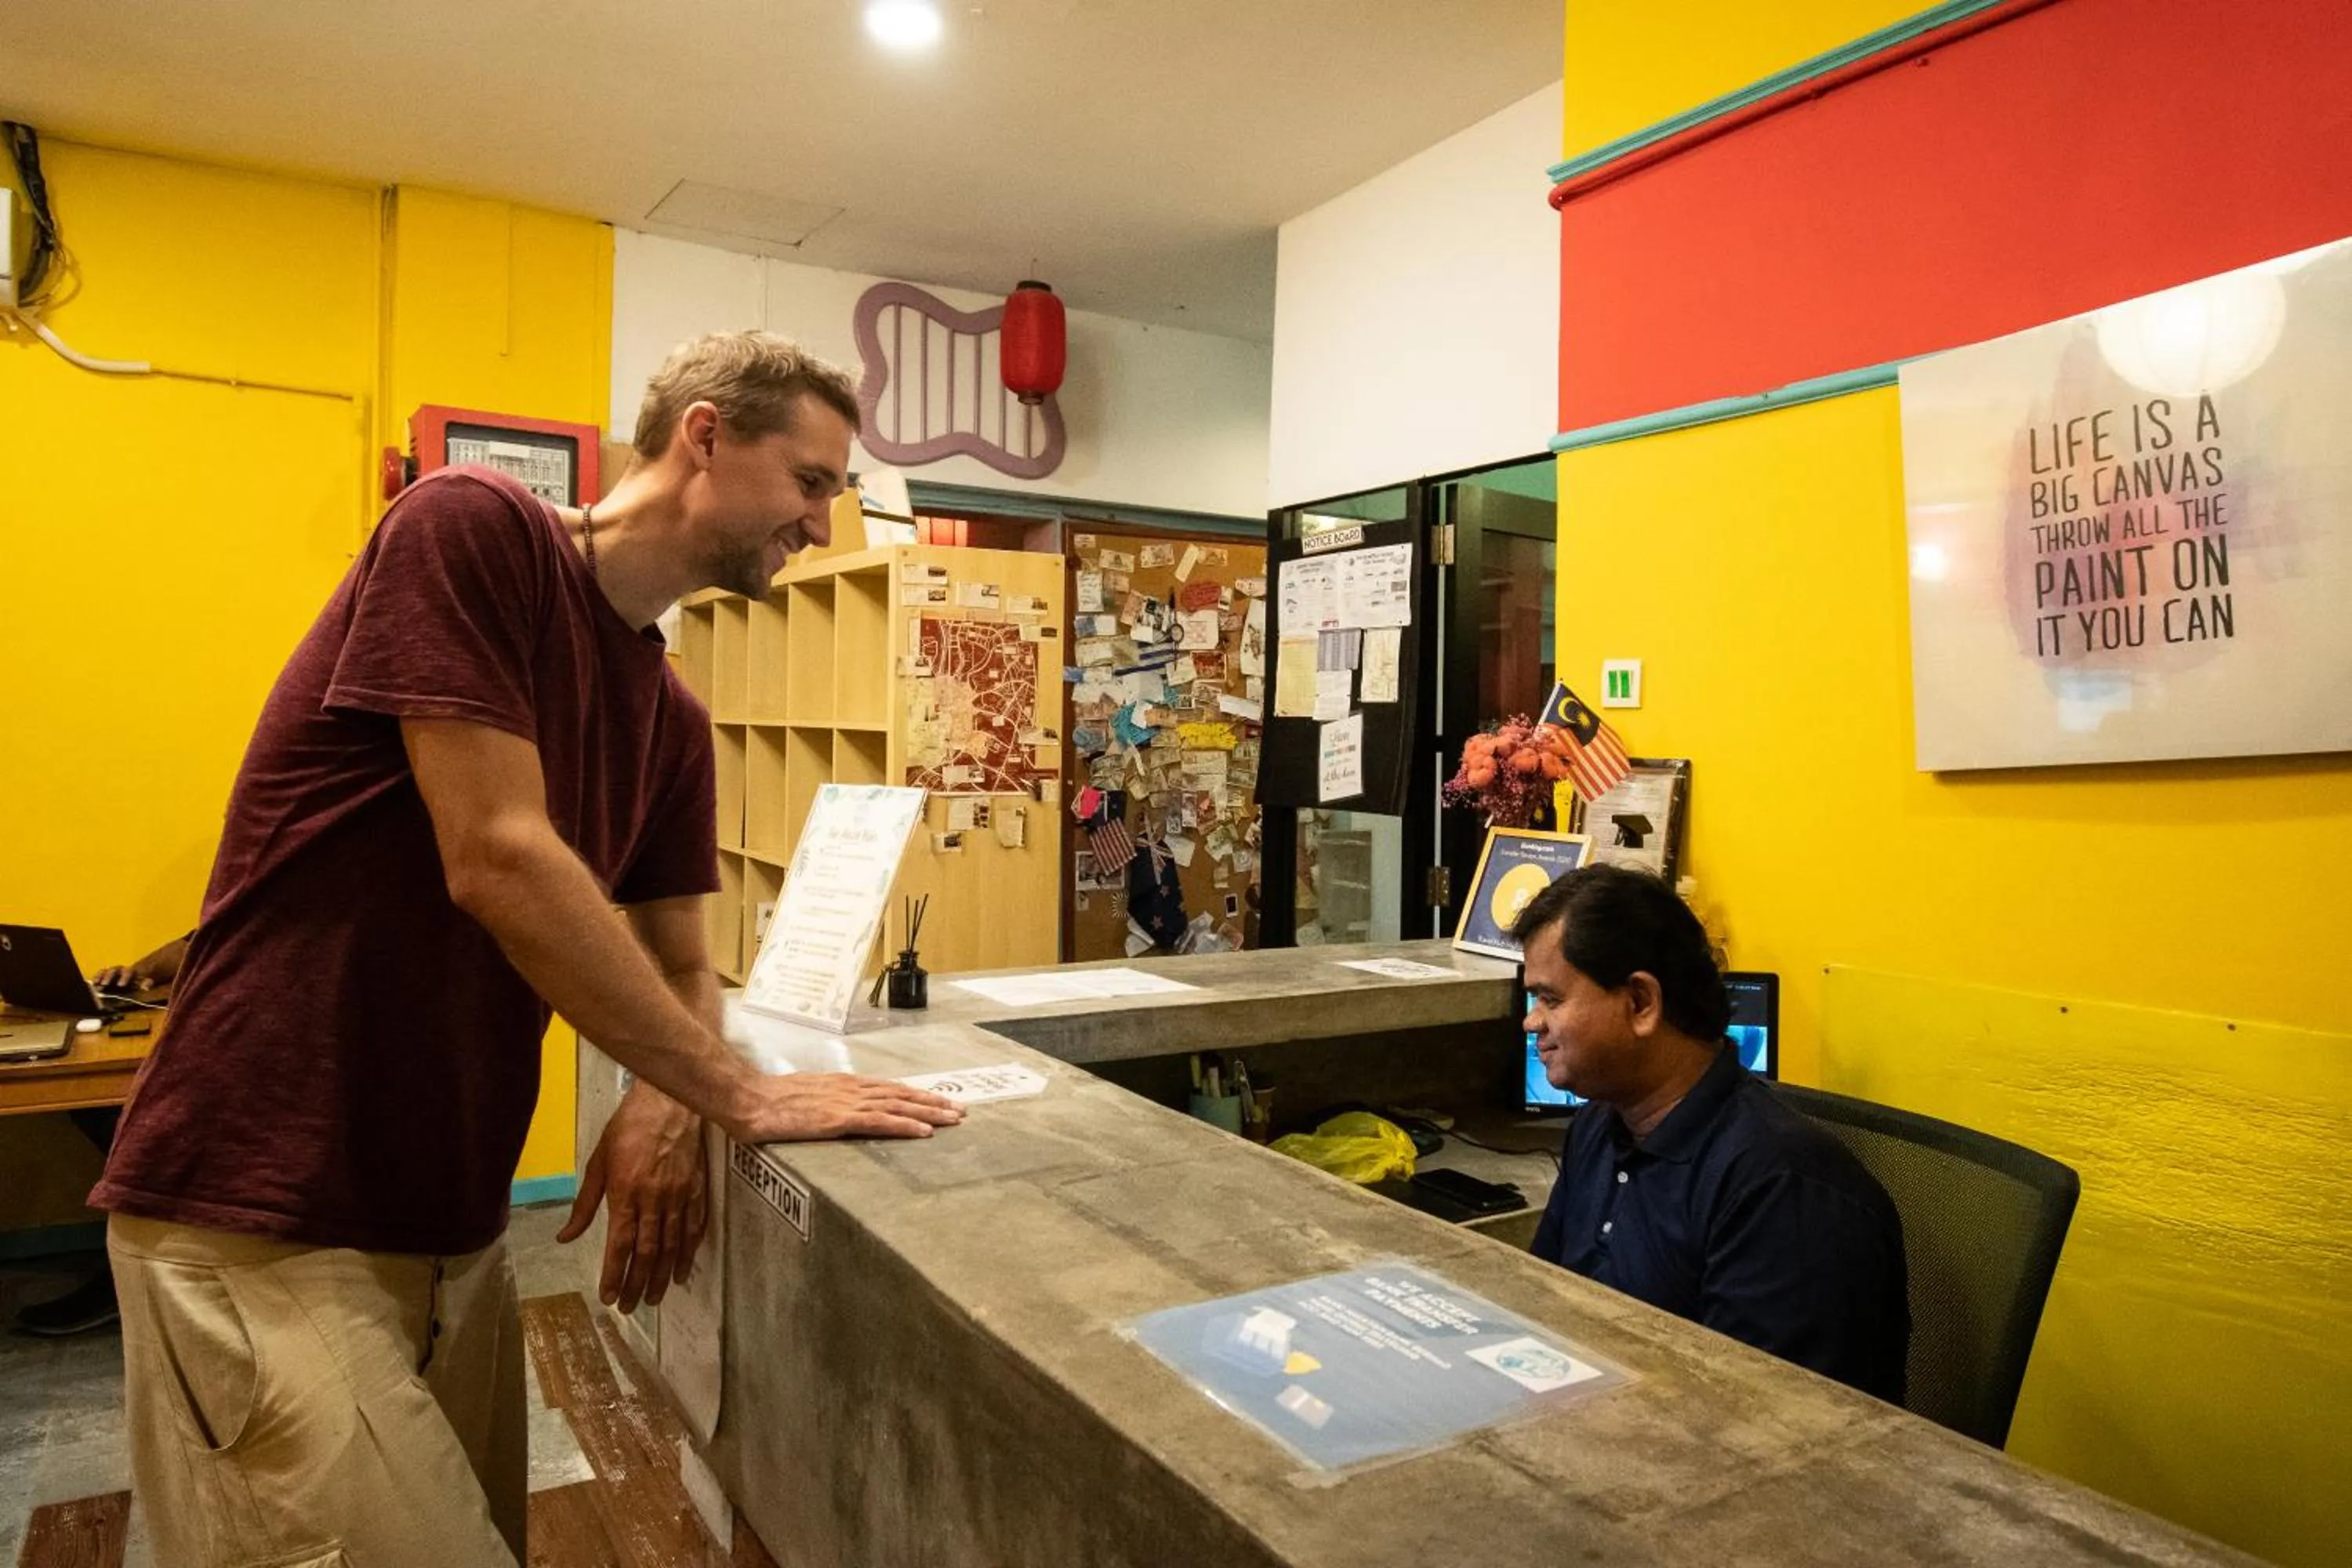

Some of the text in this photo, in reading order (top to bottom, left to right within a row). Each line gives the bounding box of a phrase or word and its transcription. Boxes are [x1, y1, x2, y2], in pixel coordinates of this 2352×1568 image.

[2030, 389, 2220, 474] LIFE IS A
[2031, 446, 2223, 518] BIG CANVAS
[1304, 528, 1359, 550] NOTICE BOARD
[2030, 493, 2228, 554] THROW ALL THE
[2034, 532, 2230, 610] PAINT ON
[2036, 593, 2234, 656] IT YOU CAN
[735, 1144, 800, 1225] RECEPTION
